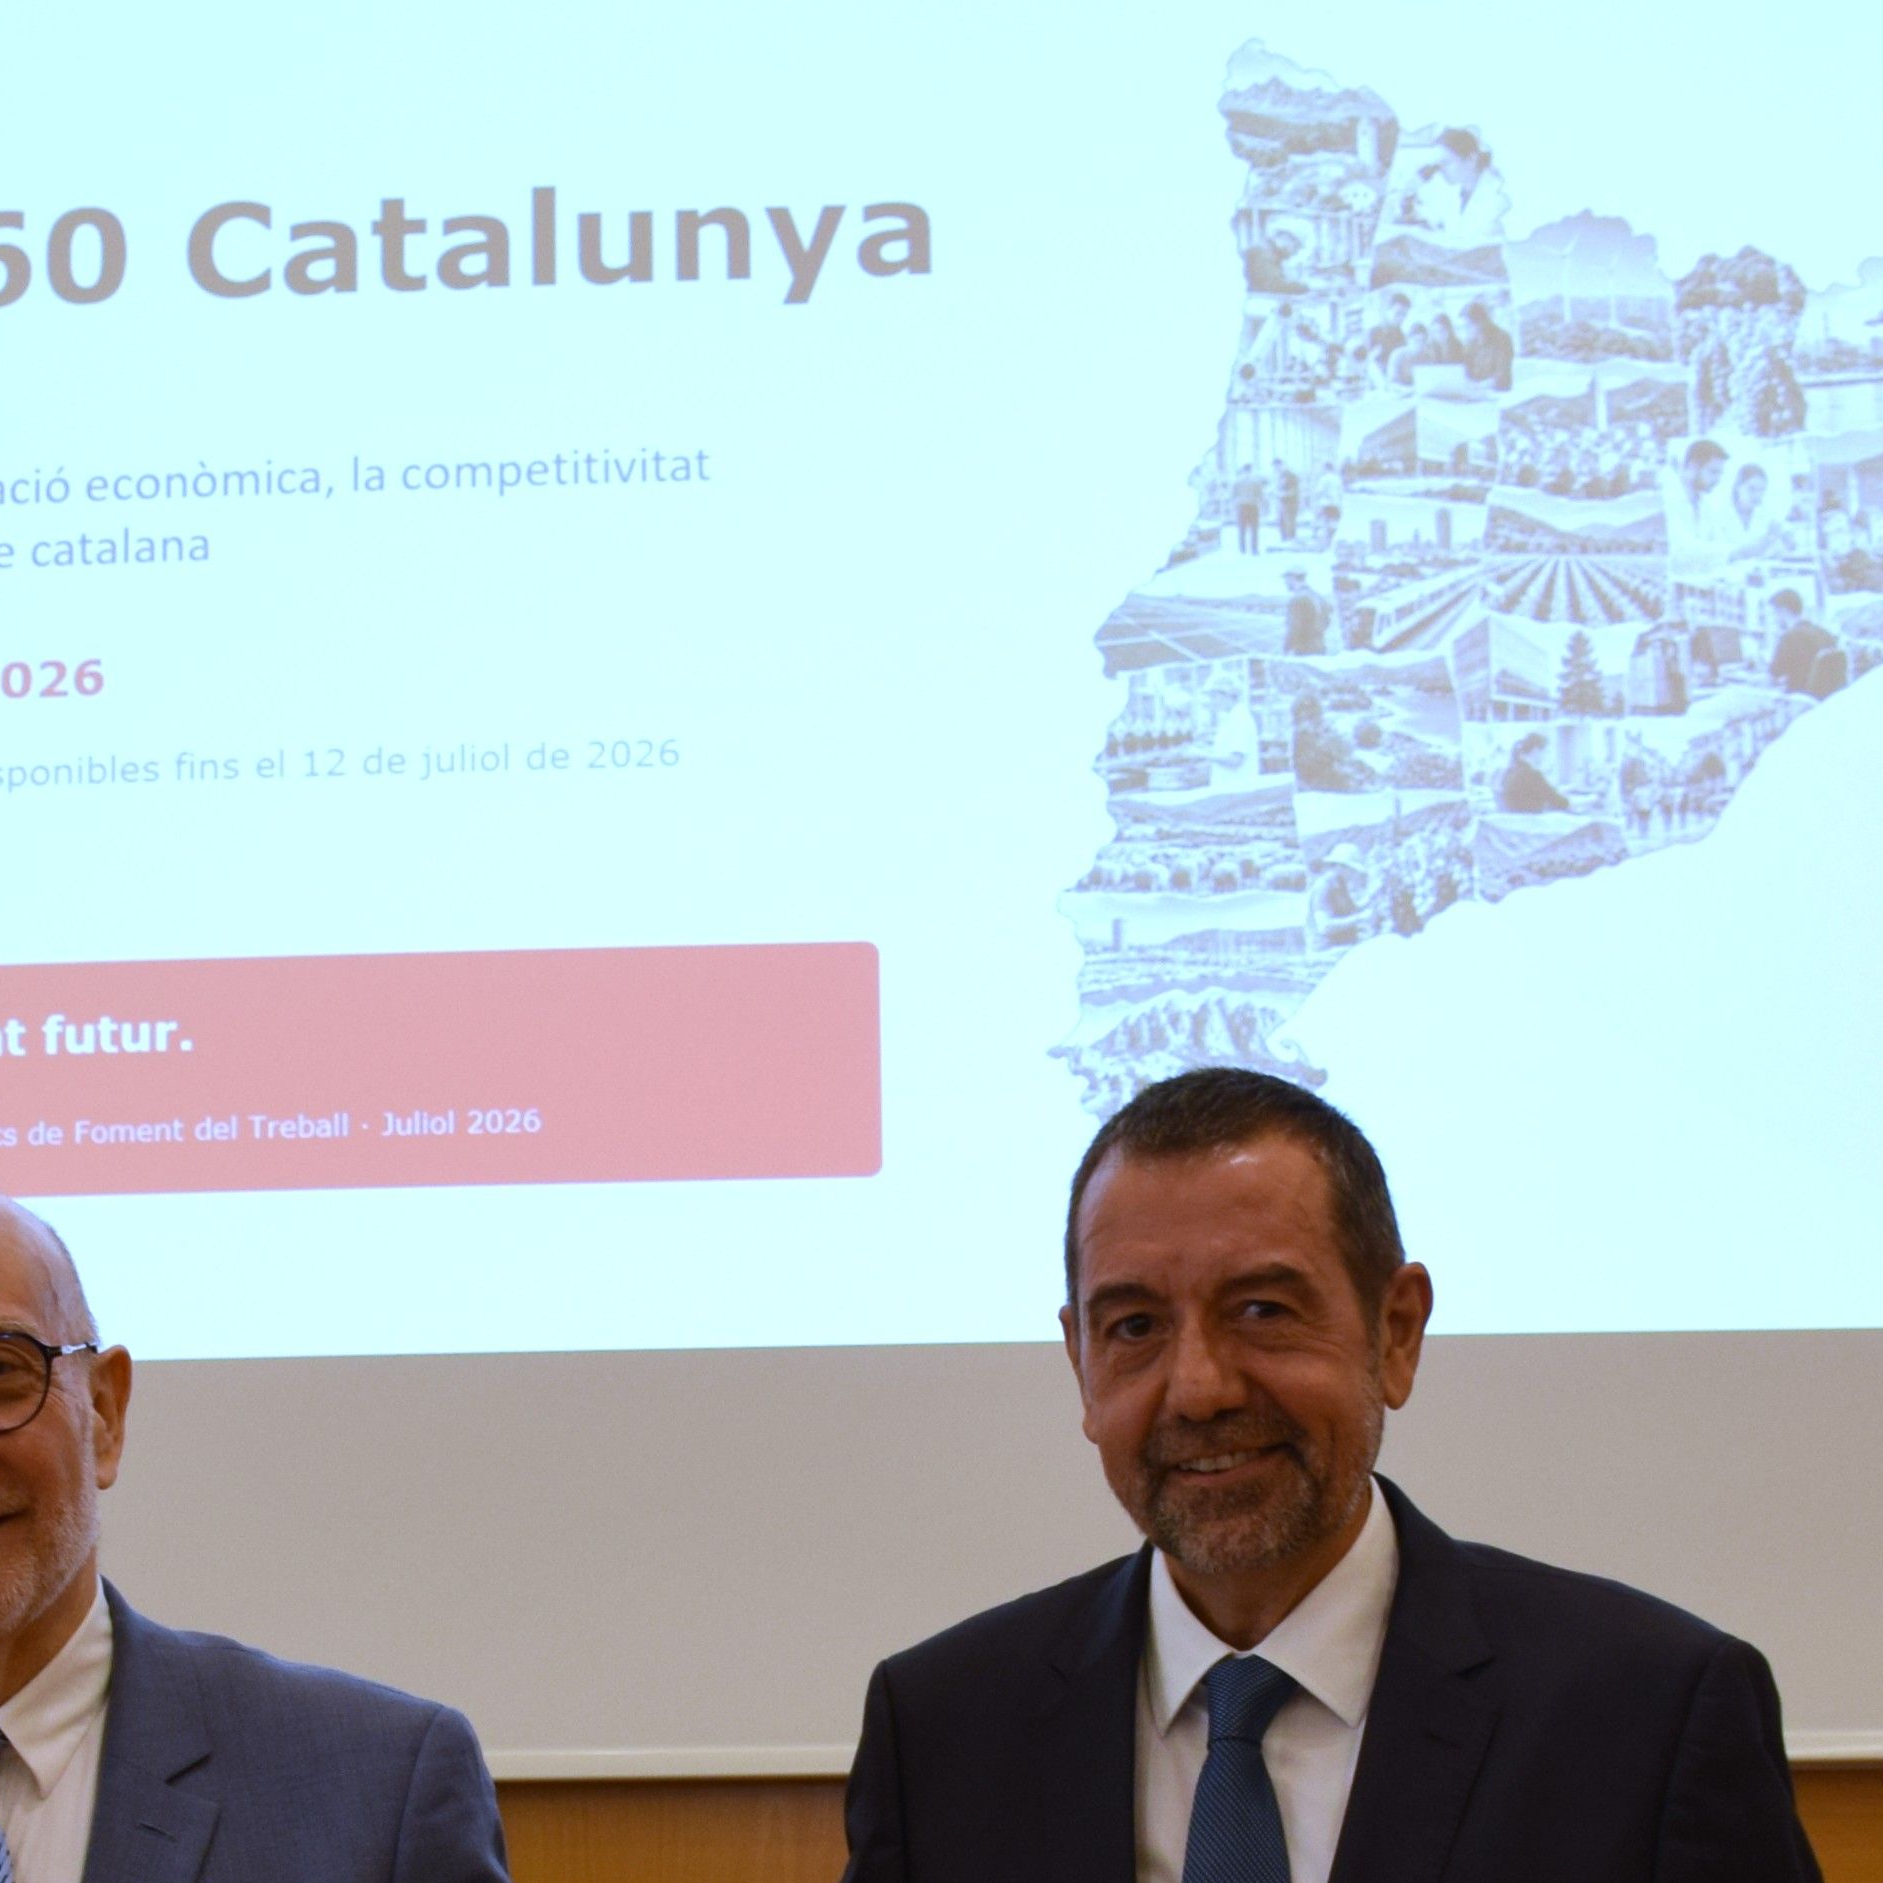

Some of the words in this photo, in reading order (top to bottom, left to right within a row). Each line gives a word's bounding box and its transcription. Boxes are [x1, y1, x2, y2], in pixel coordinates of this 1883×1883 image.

[187, 186, 932, 305] Catalunya
[86, 460, 334, 502] econòmica,
[354, 456, 385, 492] la
[402, 447, 710, 497] competitivitat
[32, 526, 210, 567] catalana
[175, 751, 240, 781] fins
[256, 748, 285, 779] el
[305, 748, 346, 777] 12
[363, 746, 407, 775] de
[420, 742, 510, 781] juliol
[527, 741, 570, 771] de
[588, 739, 680, 769] 2026
[42, 1013, 194, 1056] futur.
[27, 1120, 65, 1147] de
[74, 1118, 185, 1145] Foment
[194, 1115, 240, 1142] del
[248, 1112, 351, 1140] Treball
[381, 1109, 457, 1137] Juliol
[467, 1107, 544, 1135] 2026
